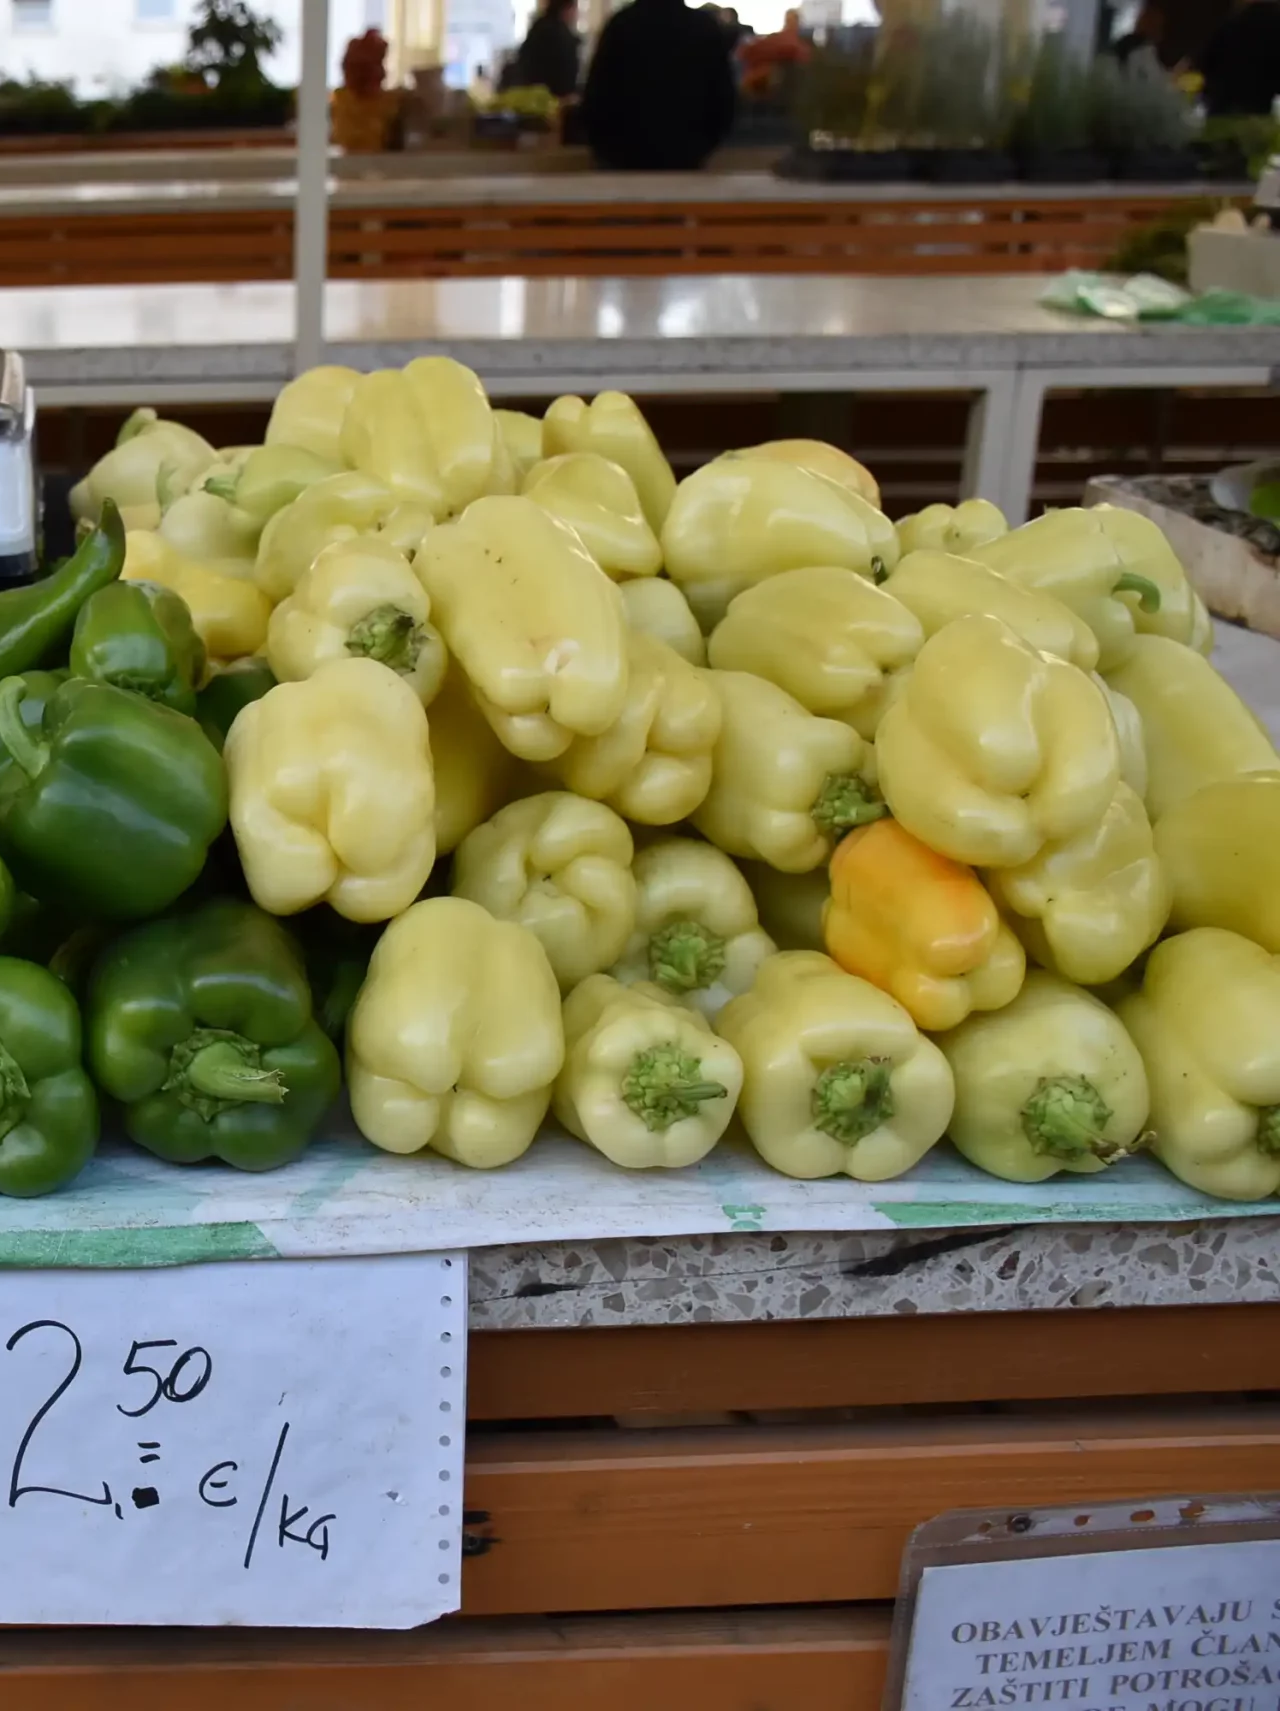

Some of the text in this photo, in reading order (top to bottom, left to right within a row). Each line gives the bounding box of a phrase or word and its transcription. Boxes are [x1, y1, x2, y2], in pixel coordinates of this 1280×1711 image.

[951, 1600, 1252, 1644] OBAVJEŠTAVAJU
[976, 1638, 1171, 1675] TEMELJEM
[951, 1659, 1280, 1708] ZAŠTITI POTROŠA
